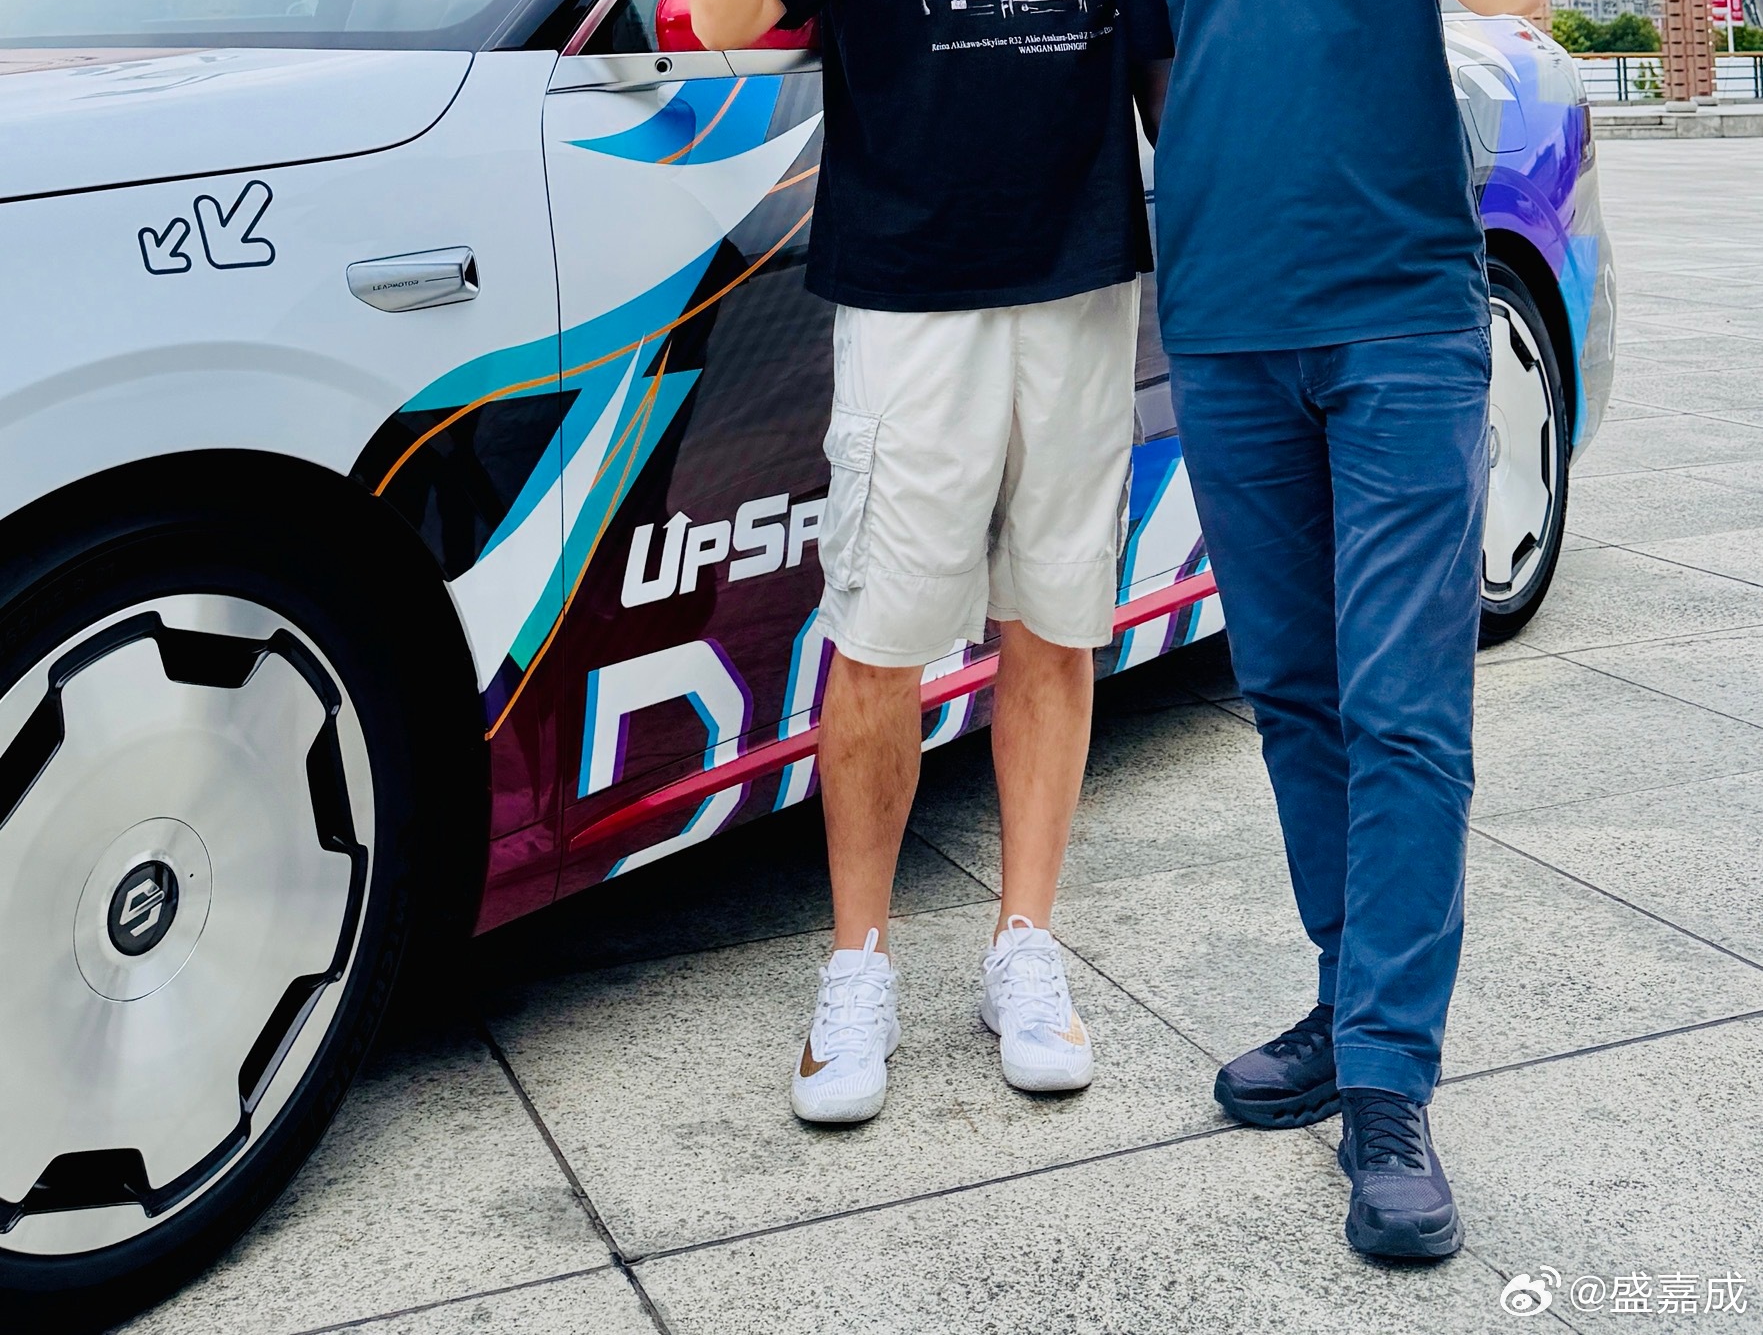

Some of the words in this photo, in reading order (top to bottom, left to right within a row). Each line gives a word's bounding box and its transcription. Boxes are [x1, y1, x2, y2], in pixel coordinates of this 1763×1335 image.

[1008, 36, 1022, 45] R32
[1018, 44, 1053, 54] WANGAN
[1054, 42, 1087, 52] MIDNIGHT
[372, 279, 419, 291] LEAPMOTOR
